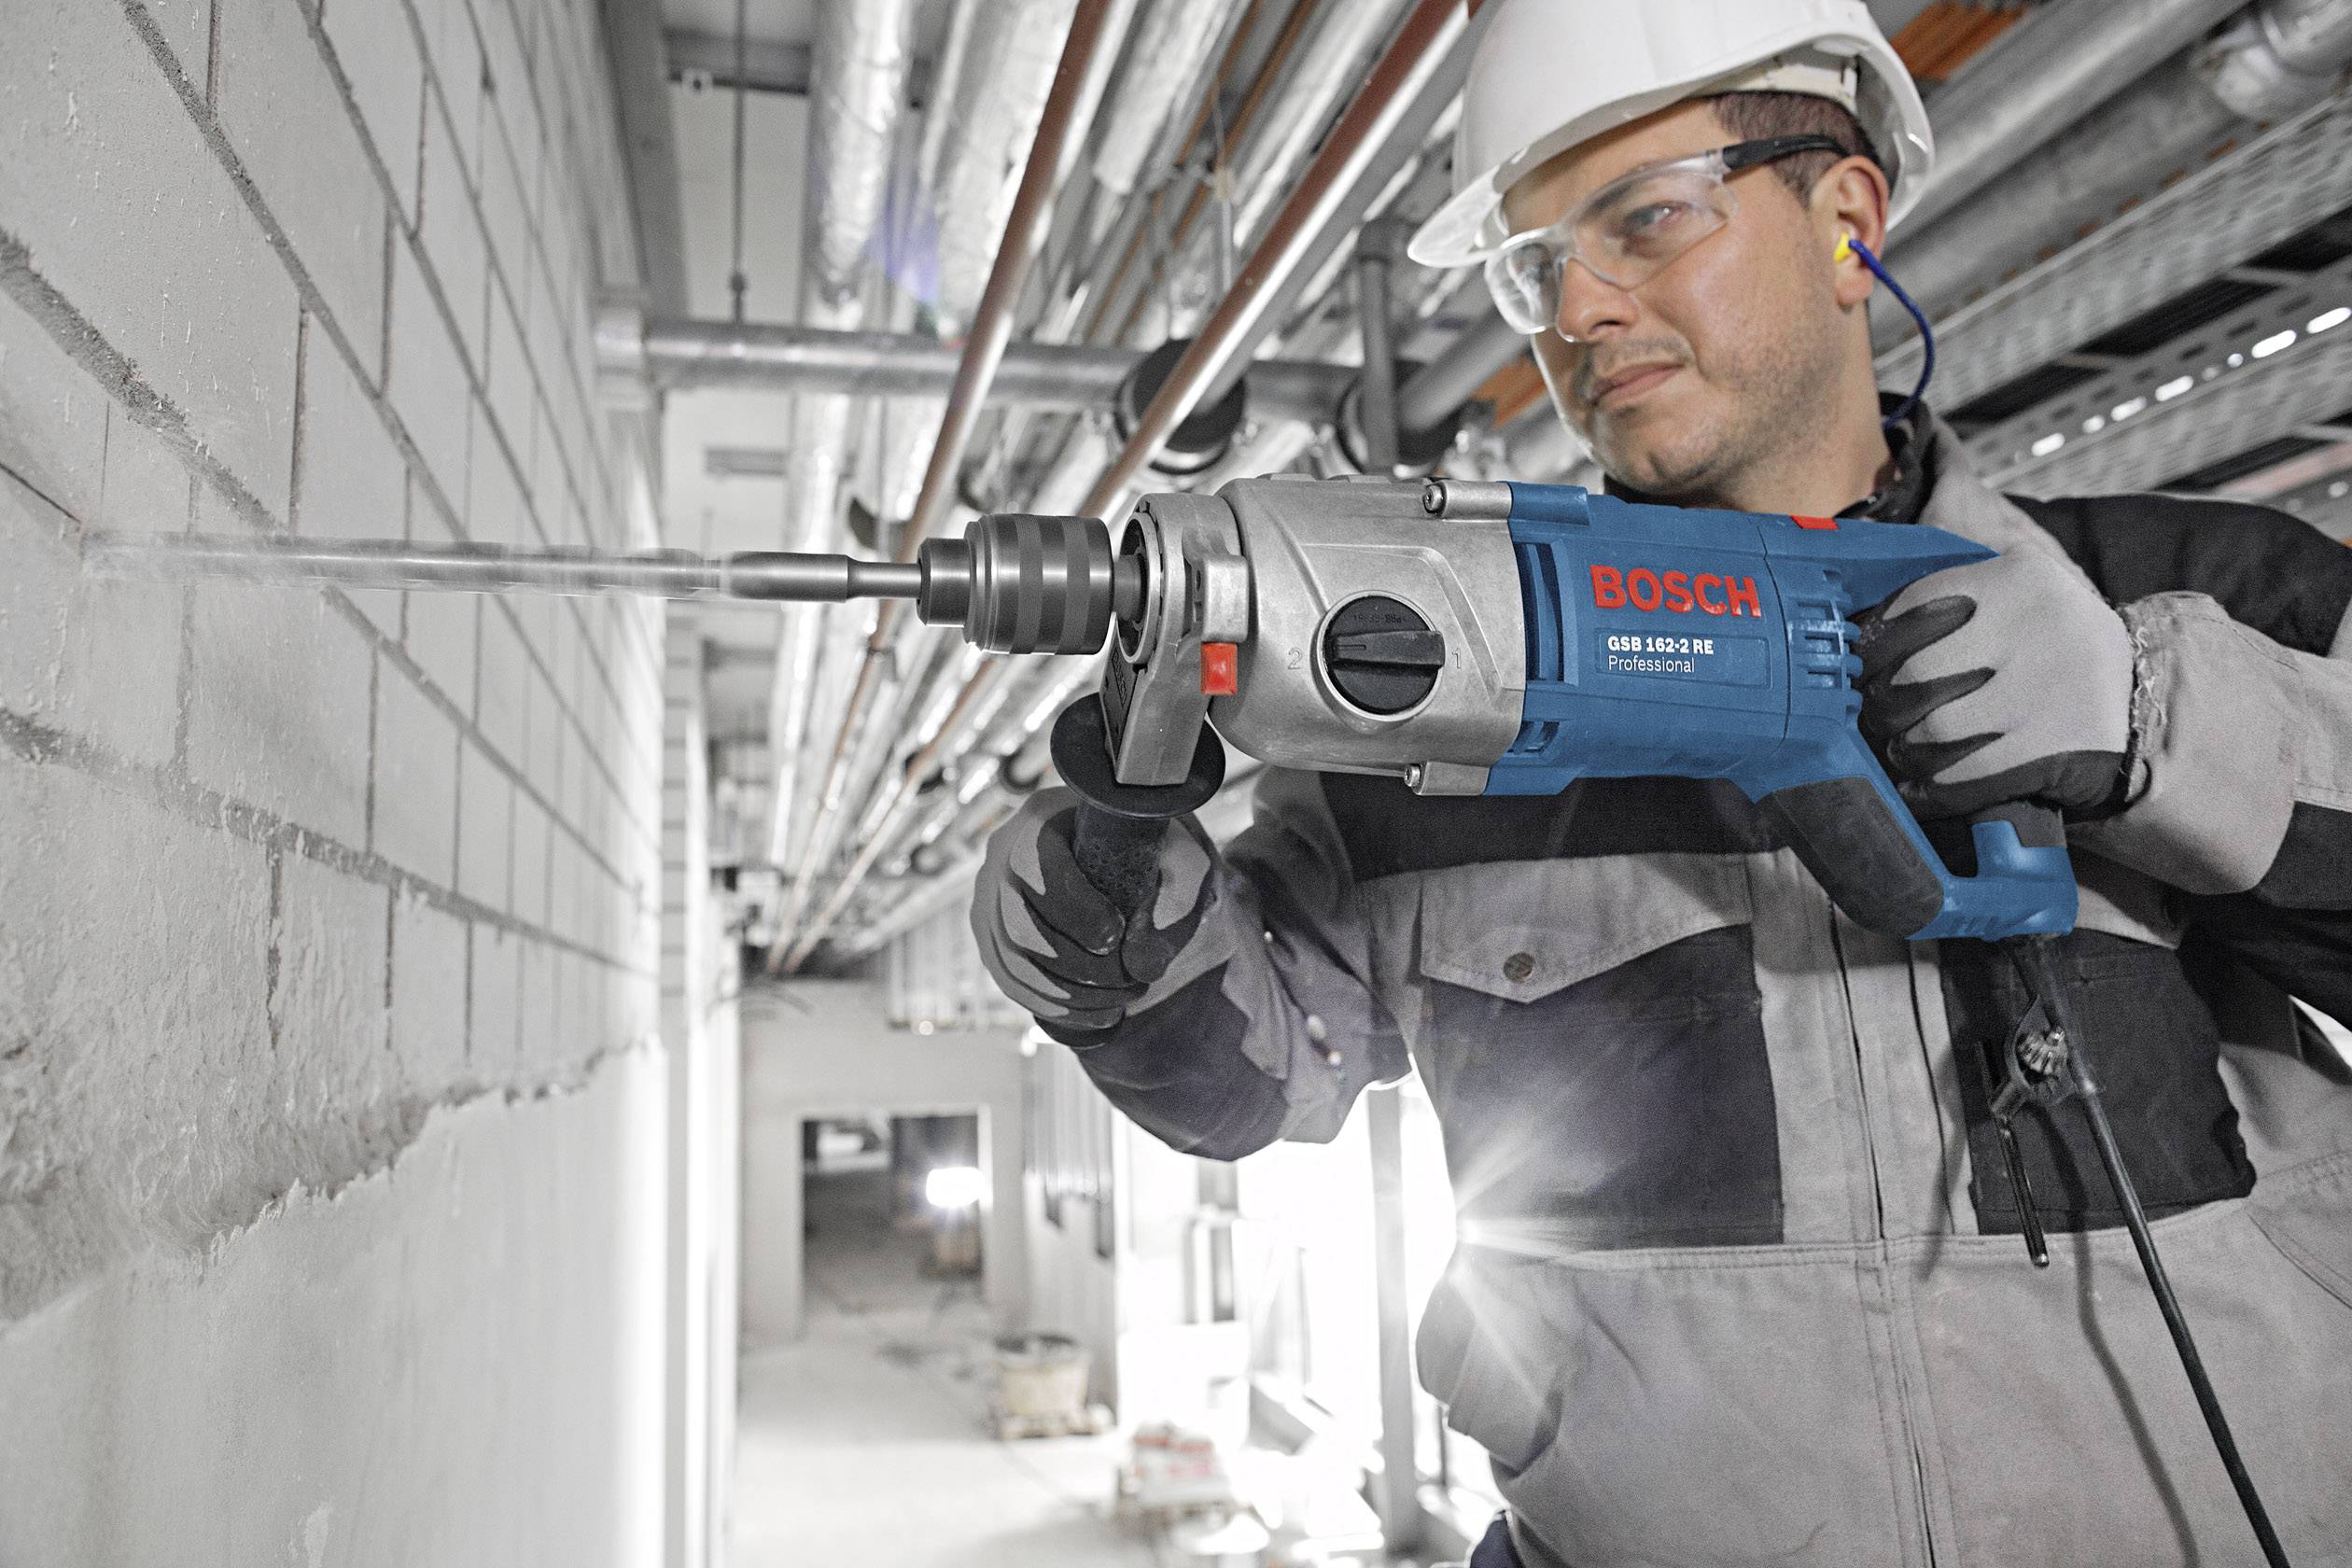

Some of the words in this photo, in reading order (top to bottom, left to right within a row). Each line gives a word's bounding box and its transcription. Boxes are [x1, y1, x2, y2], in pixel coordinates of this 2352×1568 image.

[1589, 565, 1762, 618] BOSCH
[1607, 636, 1643, 652] GSB
[1645, 636, 1689, 653] 162-2
[1692, 638, 1715, 655] RE
[1287, 647, 1302, 670] 2
[1451, 647, 1462, 670] 1
[1608, 654, 1695, 673] Professional
